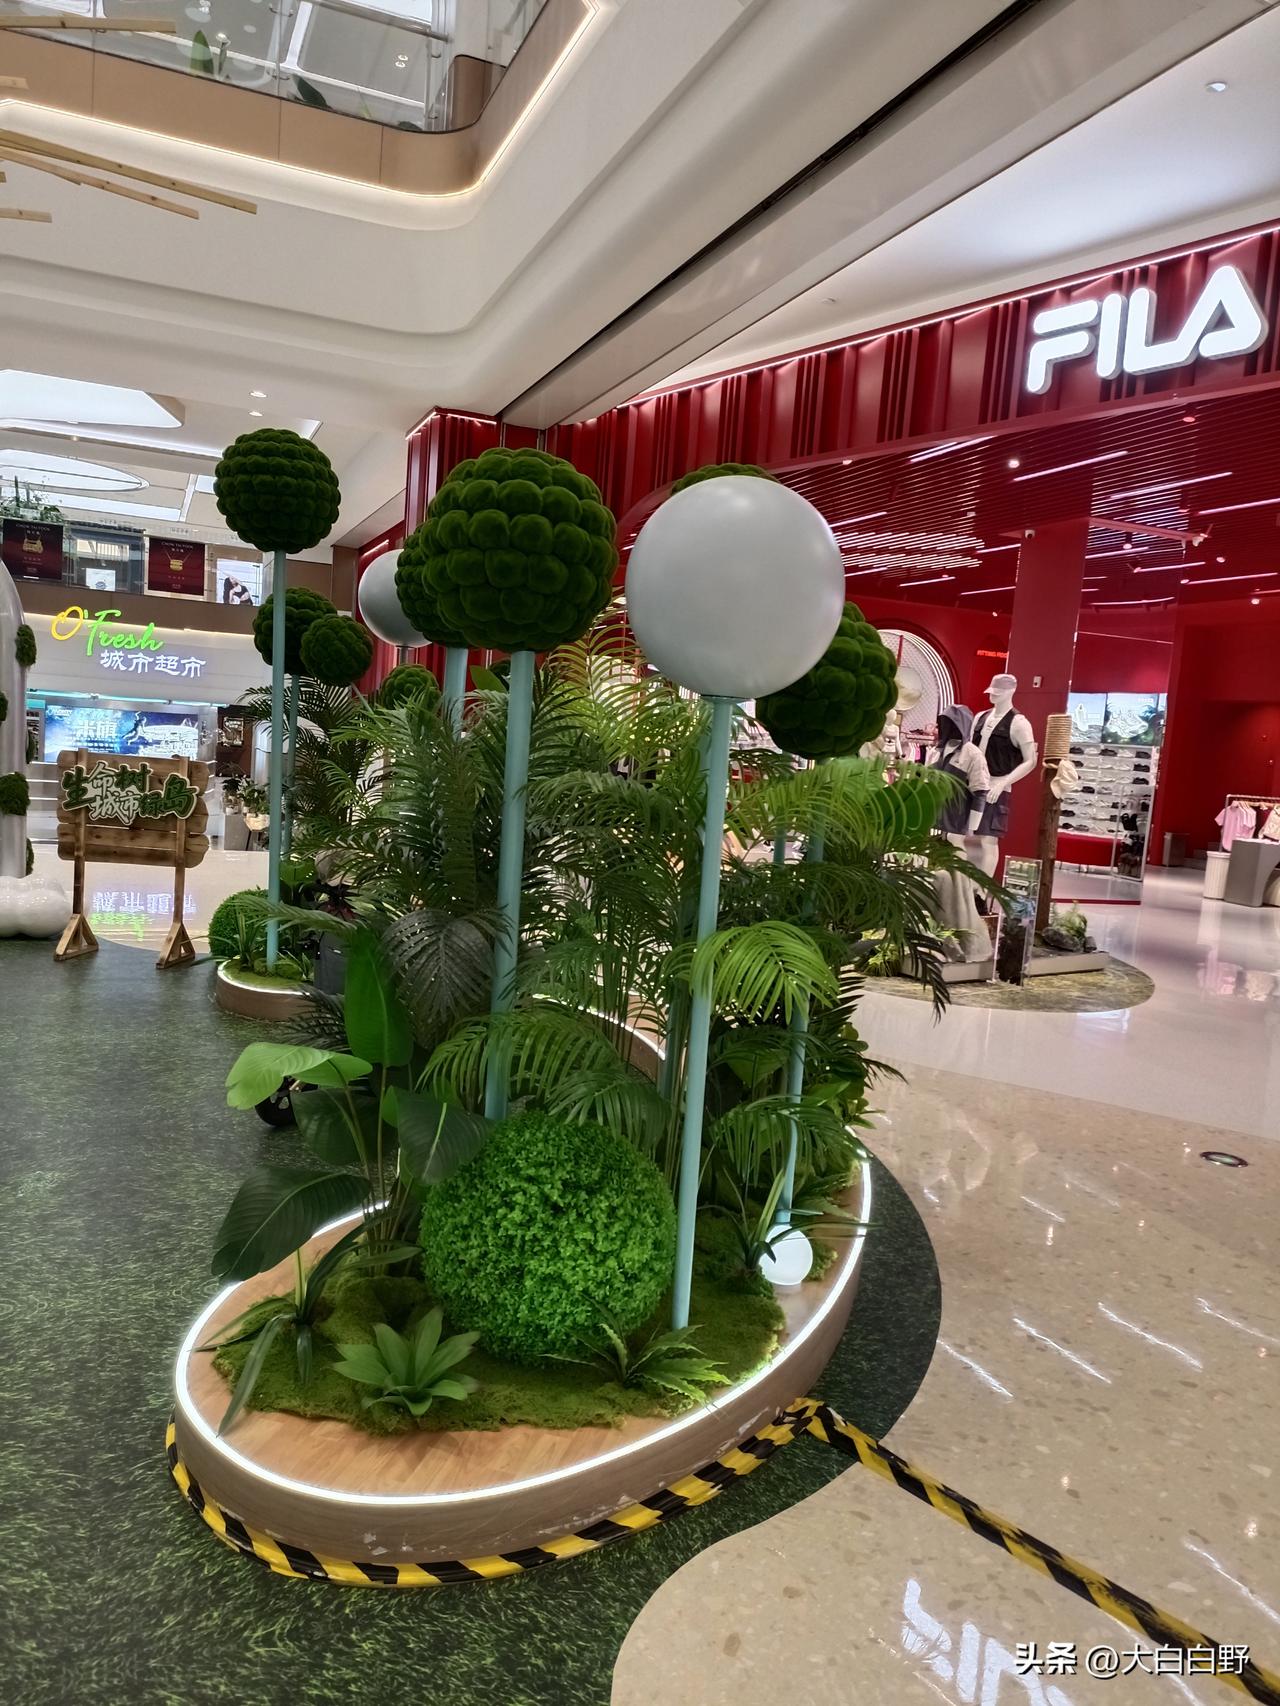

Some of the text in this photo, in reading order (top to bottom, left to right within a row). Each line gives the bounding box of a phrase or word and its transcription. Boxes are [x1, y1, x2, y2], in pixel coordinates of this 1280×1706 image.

[1026, 265, 1268, 395] FILA
[51, 605, 165, 657] O'Fresh
[100, 649, 207, 678] 城市超市
[61, 760, 153, 811] 生命树
[89, 772, 199, 826] 城市绿岛
